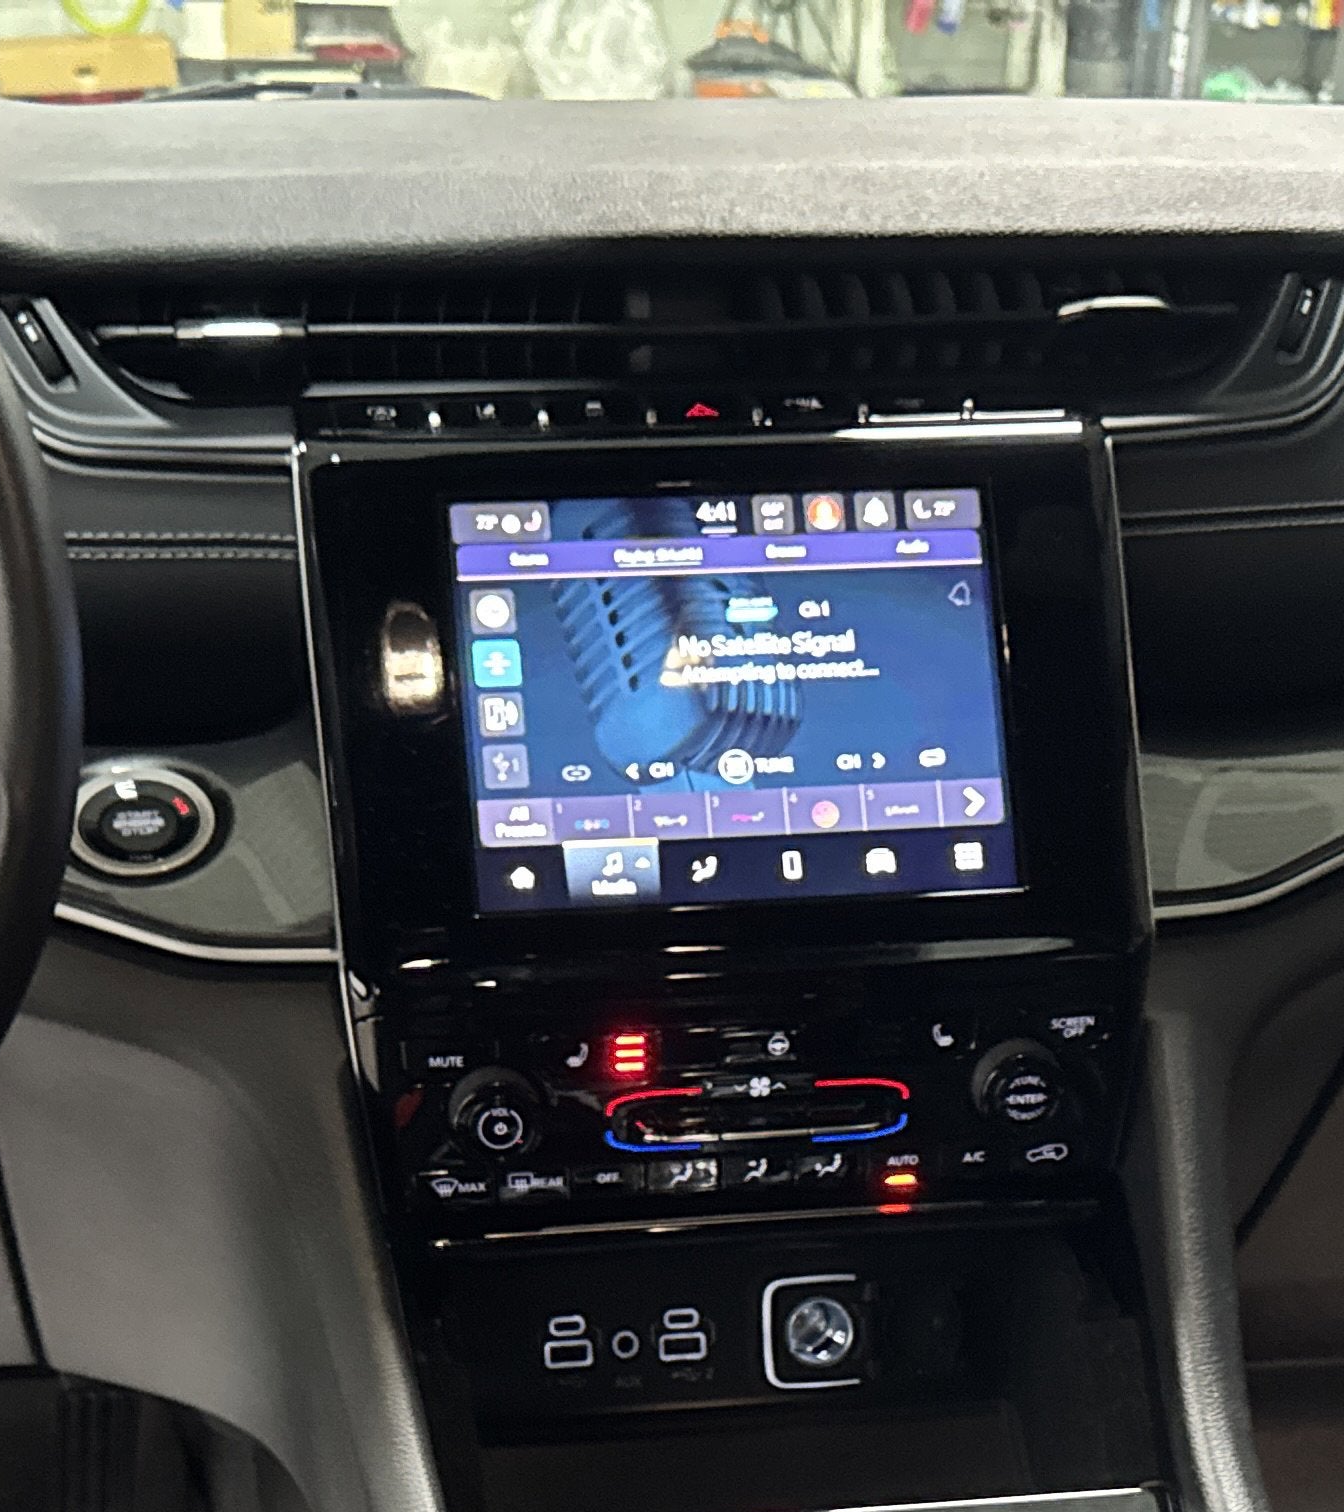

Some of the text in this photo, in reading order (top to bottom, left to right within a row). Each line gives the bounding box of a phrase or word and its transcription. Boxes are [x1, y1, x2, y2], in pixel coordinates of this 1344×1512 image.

[696, 500, 737, 522] 4:41
[678, 628, 855, 658] No Satellite Signal
[776, 661, 796, 680] to
[1050, 1015, 1096, 1031] SCREEN
[428, 1055, 465, 1068] MUTE
[886, 1154, 920, 1167] AUTO
[962, 1150, 986, 1163] A/C
[596, 1172, 621, 1184] OFF
[458, 1181, 487, 1193] MAX
